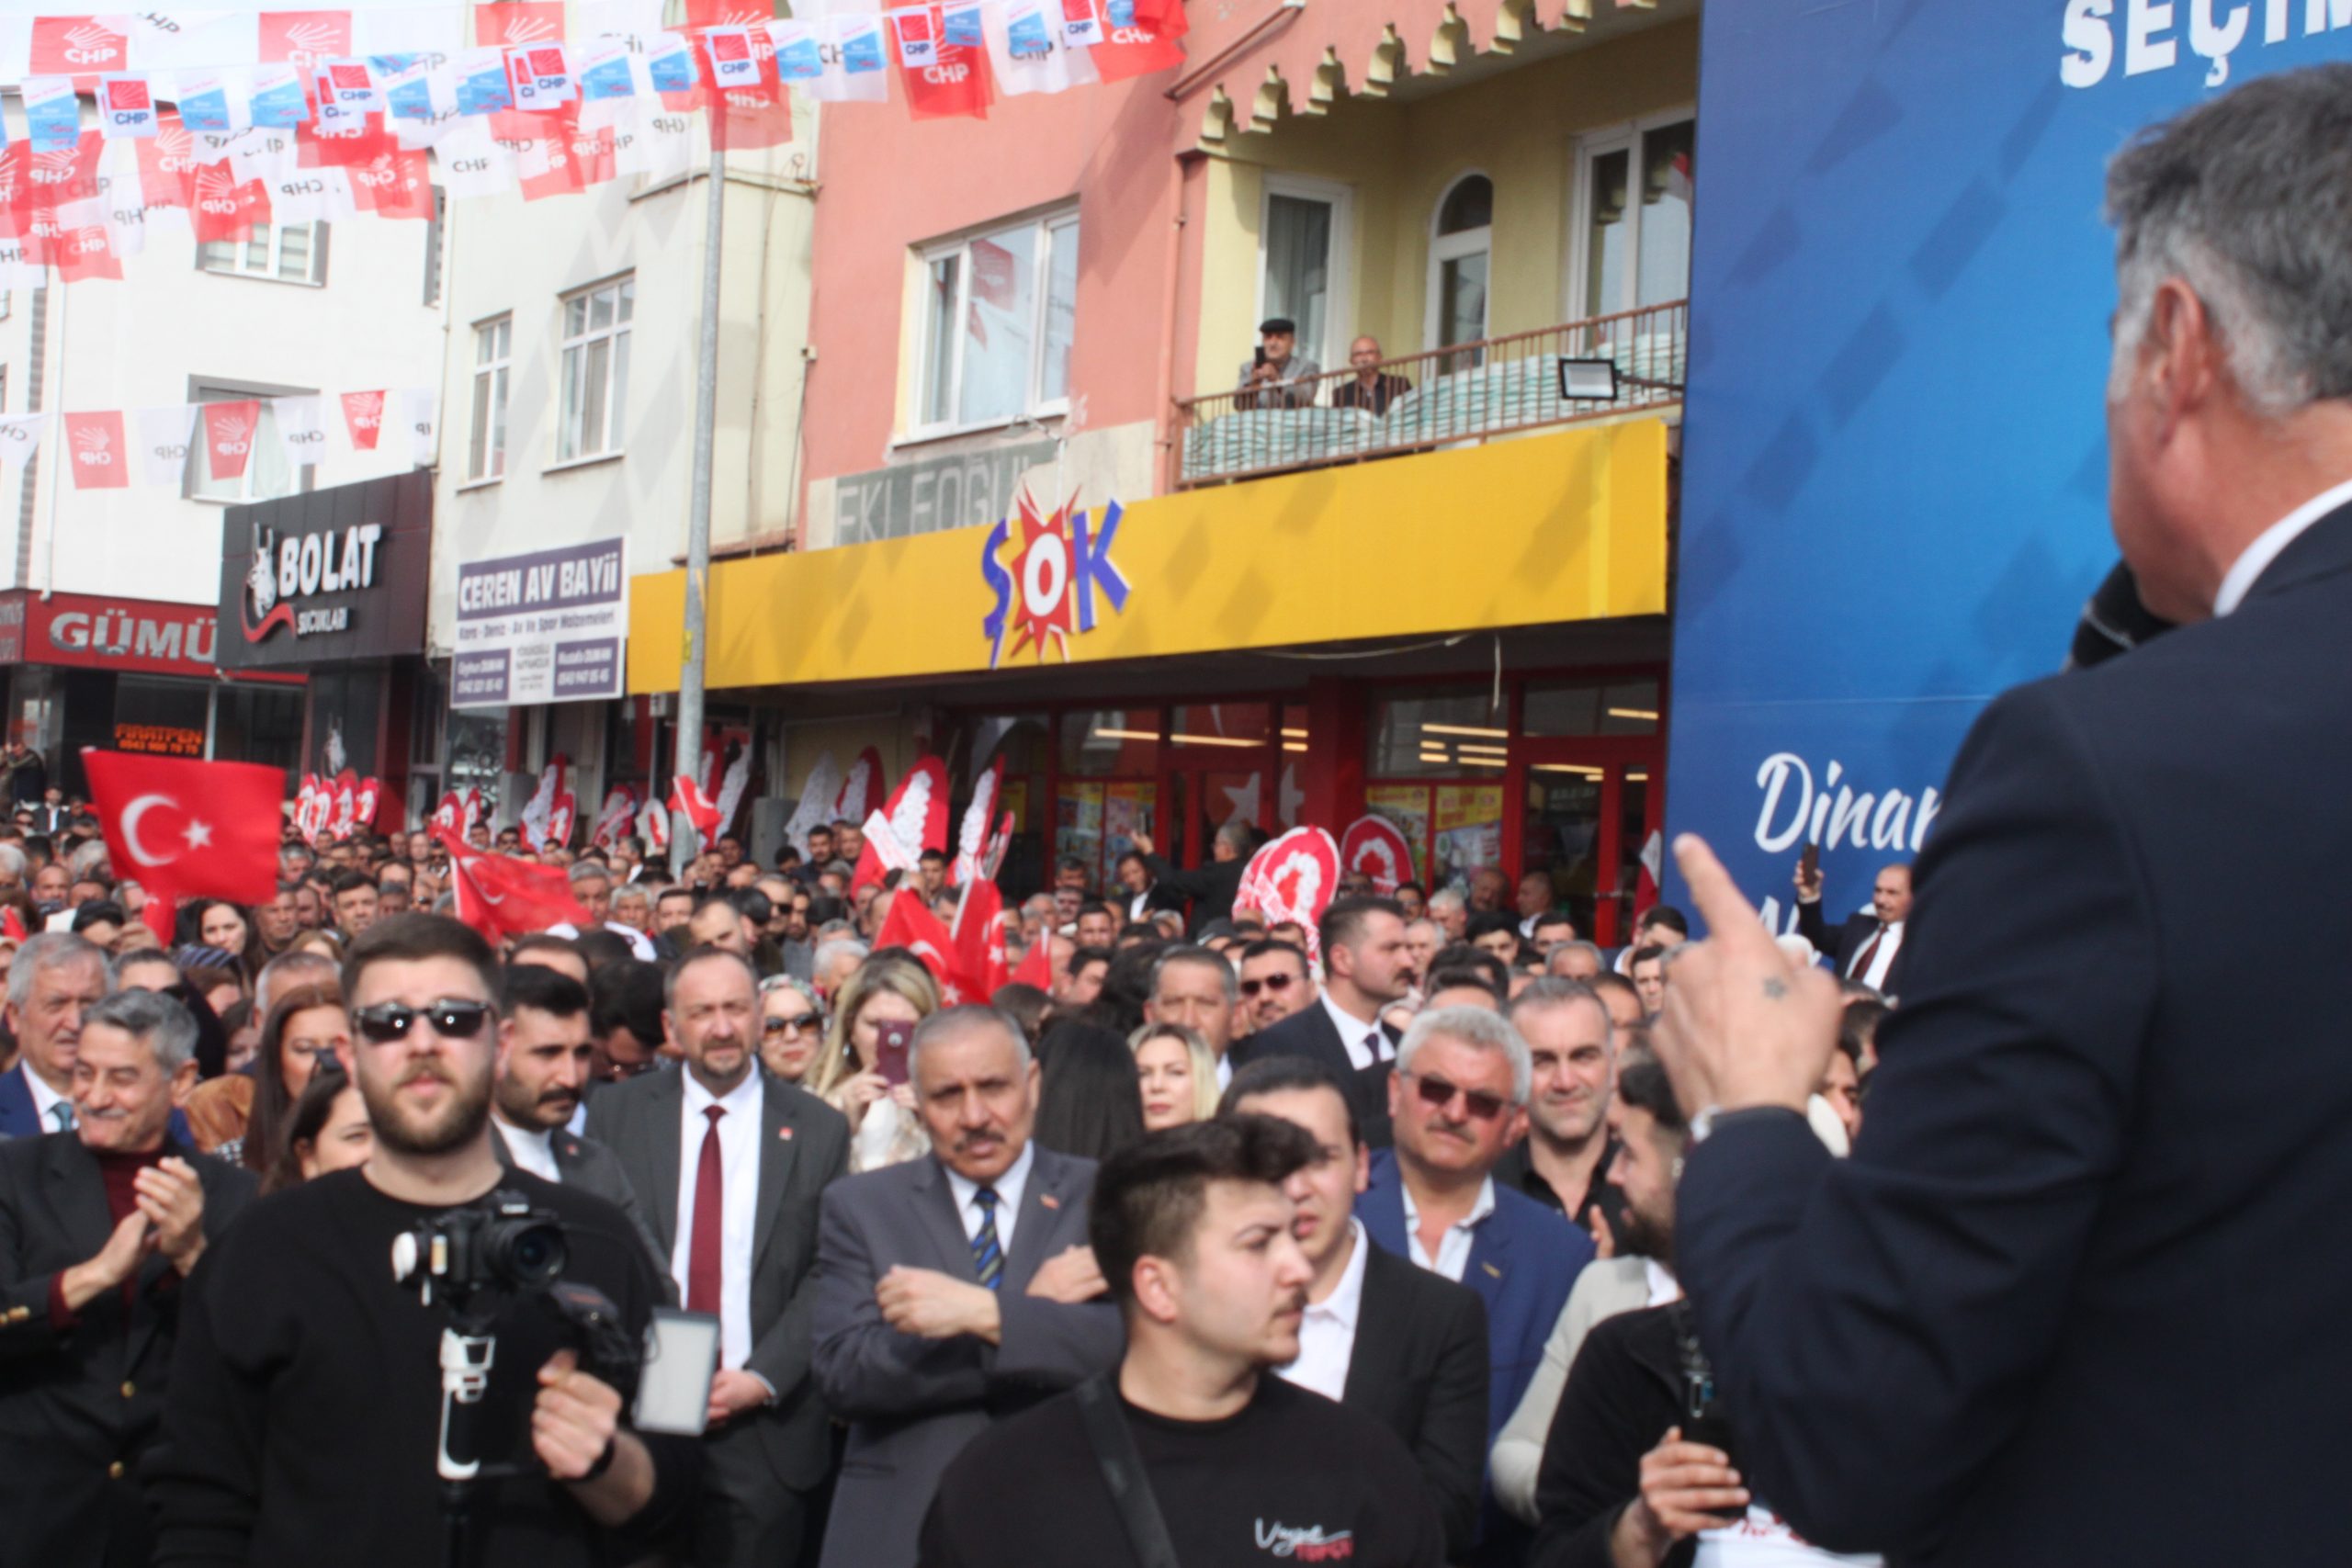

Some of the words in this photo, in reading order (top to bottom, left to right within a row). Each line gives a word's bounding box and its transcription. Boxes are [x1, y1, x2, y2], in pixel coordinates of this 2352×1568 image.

[64, 48, 119, 64] CHP
[818, 44, 843, 63] CH
[905, 43, 930, 55] CHP
[722, 62, 751, 73] CHP
[923, 62, 969, 84] CHP
[538, 76, 566, 89] CHP
[115, 112, 149, 125] CHP
[0, 248, 29, 263] HP
[278, 524, 380, 597] BOLAT
[460, 569, 521, 613] CEREN
[525, 564, 556, 604] AV
[50, 608, 218, 663] GÜMÜ
